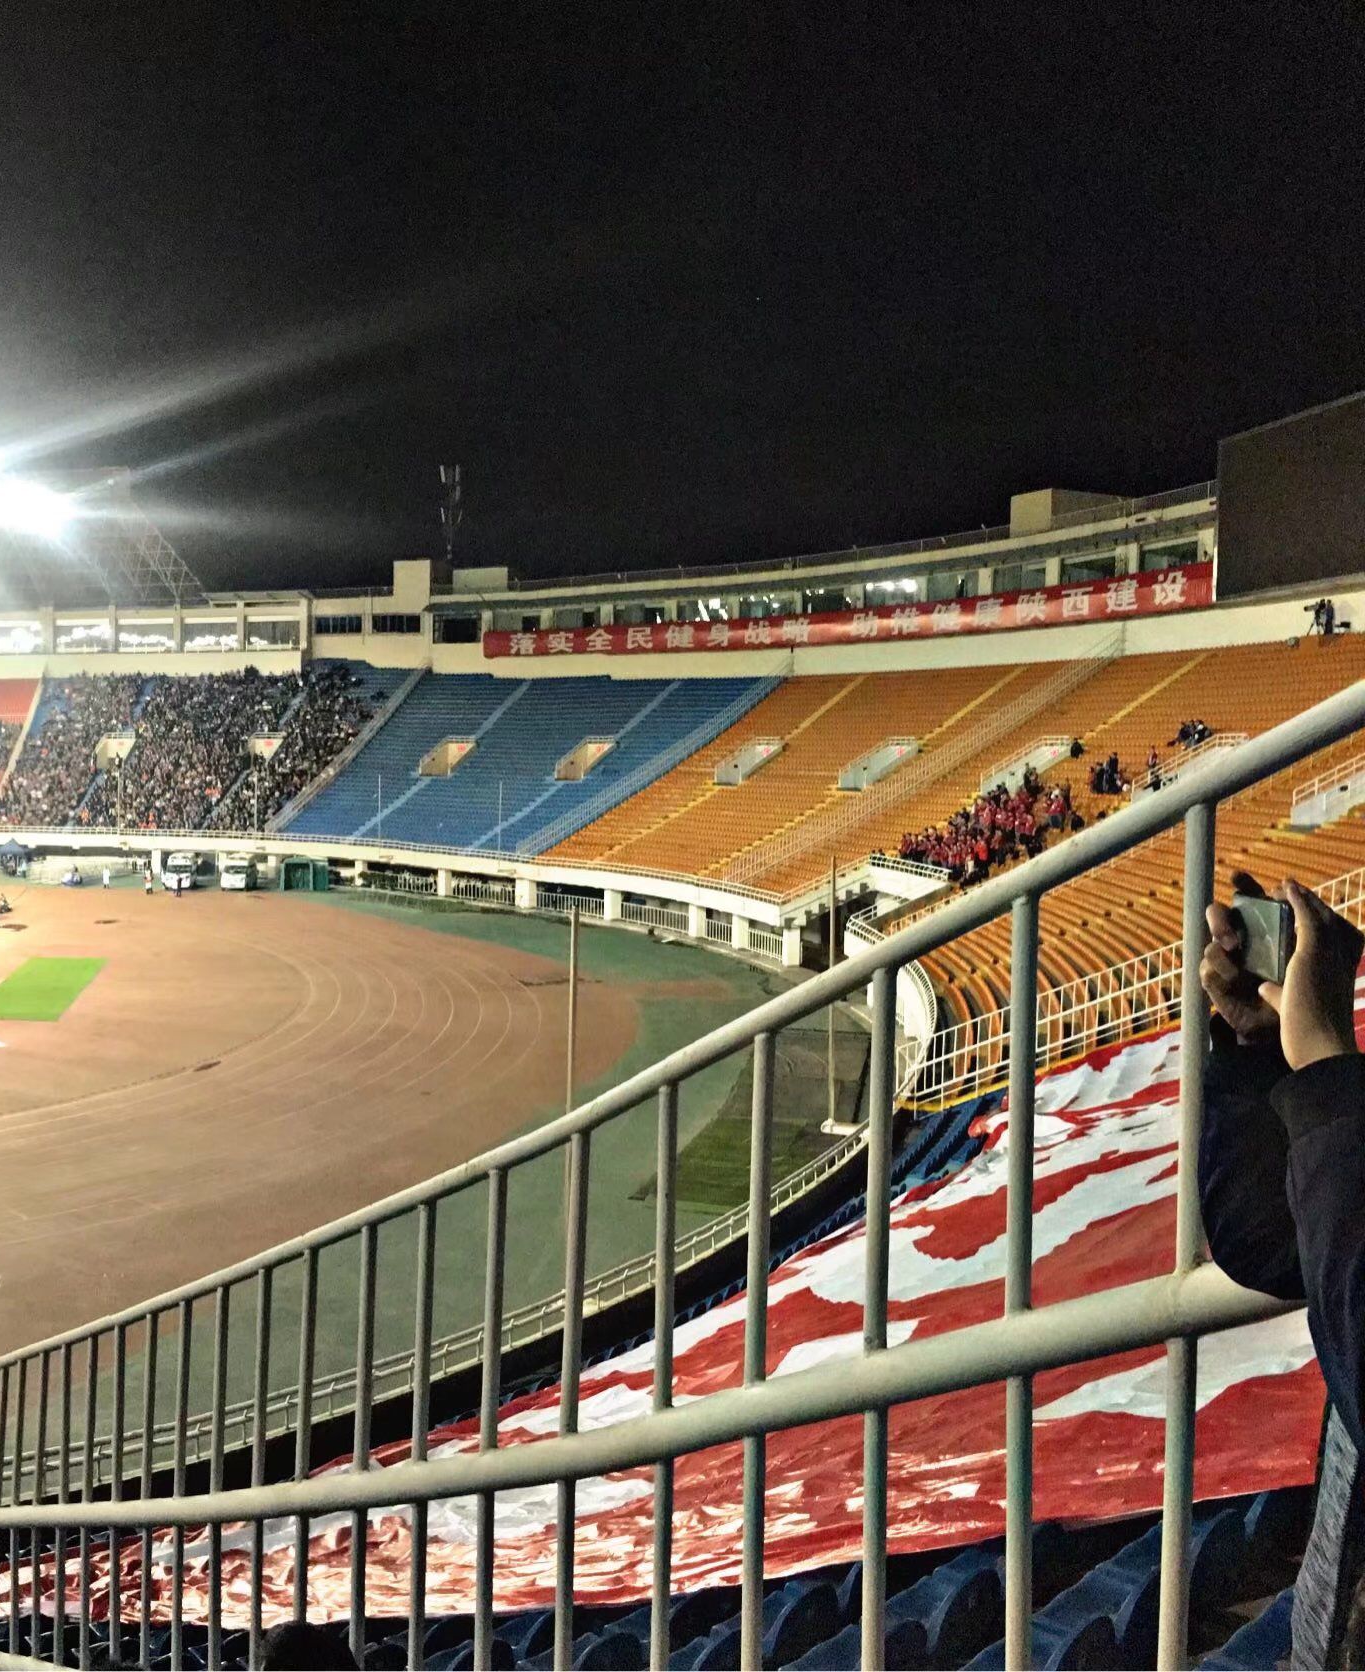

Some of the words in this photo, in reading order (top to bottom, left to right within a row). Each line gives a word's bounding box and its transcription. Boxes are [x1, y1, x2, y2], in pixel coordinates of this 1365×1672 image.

[509, 619, 810, 655] 落实全民健身战略
[850, 571, 1188, 637] 助推健康陕西建设
